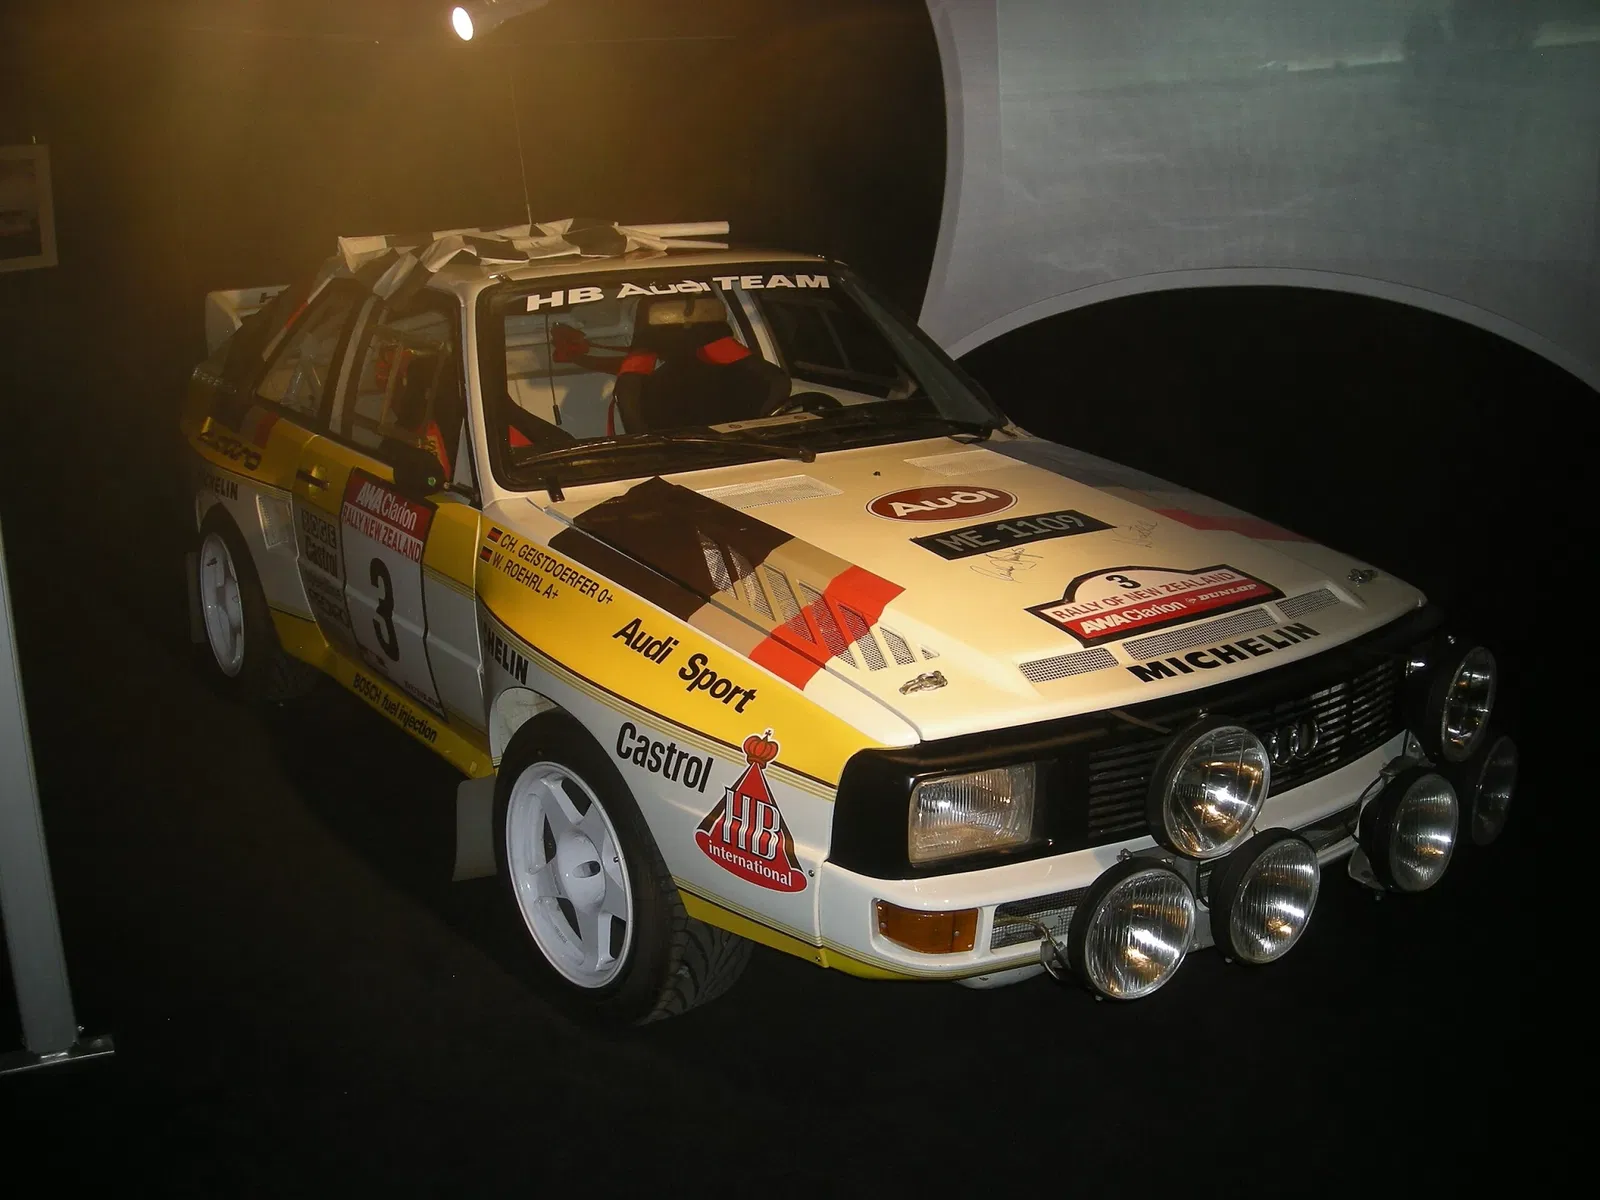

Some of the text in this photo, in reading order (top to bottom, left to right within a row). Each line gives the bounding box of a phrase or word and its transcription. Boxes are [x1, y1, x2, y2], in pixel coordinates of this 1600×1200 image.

[526, 274, 830, 312] HB Audi TEAM
[888, 490, 1000, 517] Audi
[343, 504, 421, 563] RALLY NEW ZEALAND
[936, 528, 1000, 552] ME
[997, 514, 1085, 539] 1109
[492, 552, 559, 599] W. ROEHRL A+
[500, 534, 519, 553] CH.
[518, 544, 600, 598] GEISTDOERFER
[1106, 574, 1141, 589] 3
[1198, 583, 1257, 601] DUNLOP
[370, 557, 399, 662] 3
[1052, 572, 1235, 619] RALLY OF NEW ZEALAND
[612, 617, 757, 714] Audi Sport
[1126, 622, 1320, 683] MICHELIN
[353, 672, 382, 704] BOSCH
[381, 693, 401, 717] fuel
[397, 704, 437, 743] injection
[616, 722, 714, 793] Castrol
[722, 786, 782, 861] HB
[708, 840, 793, 887] international
